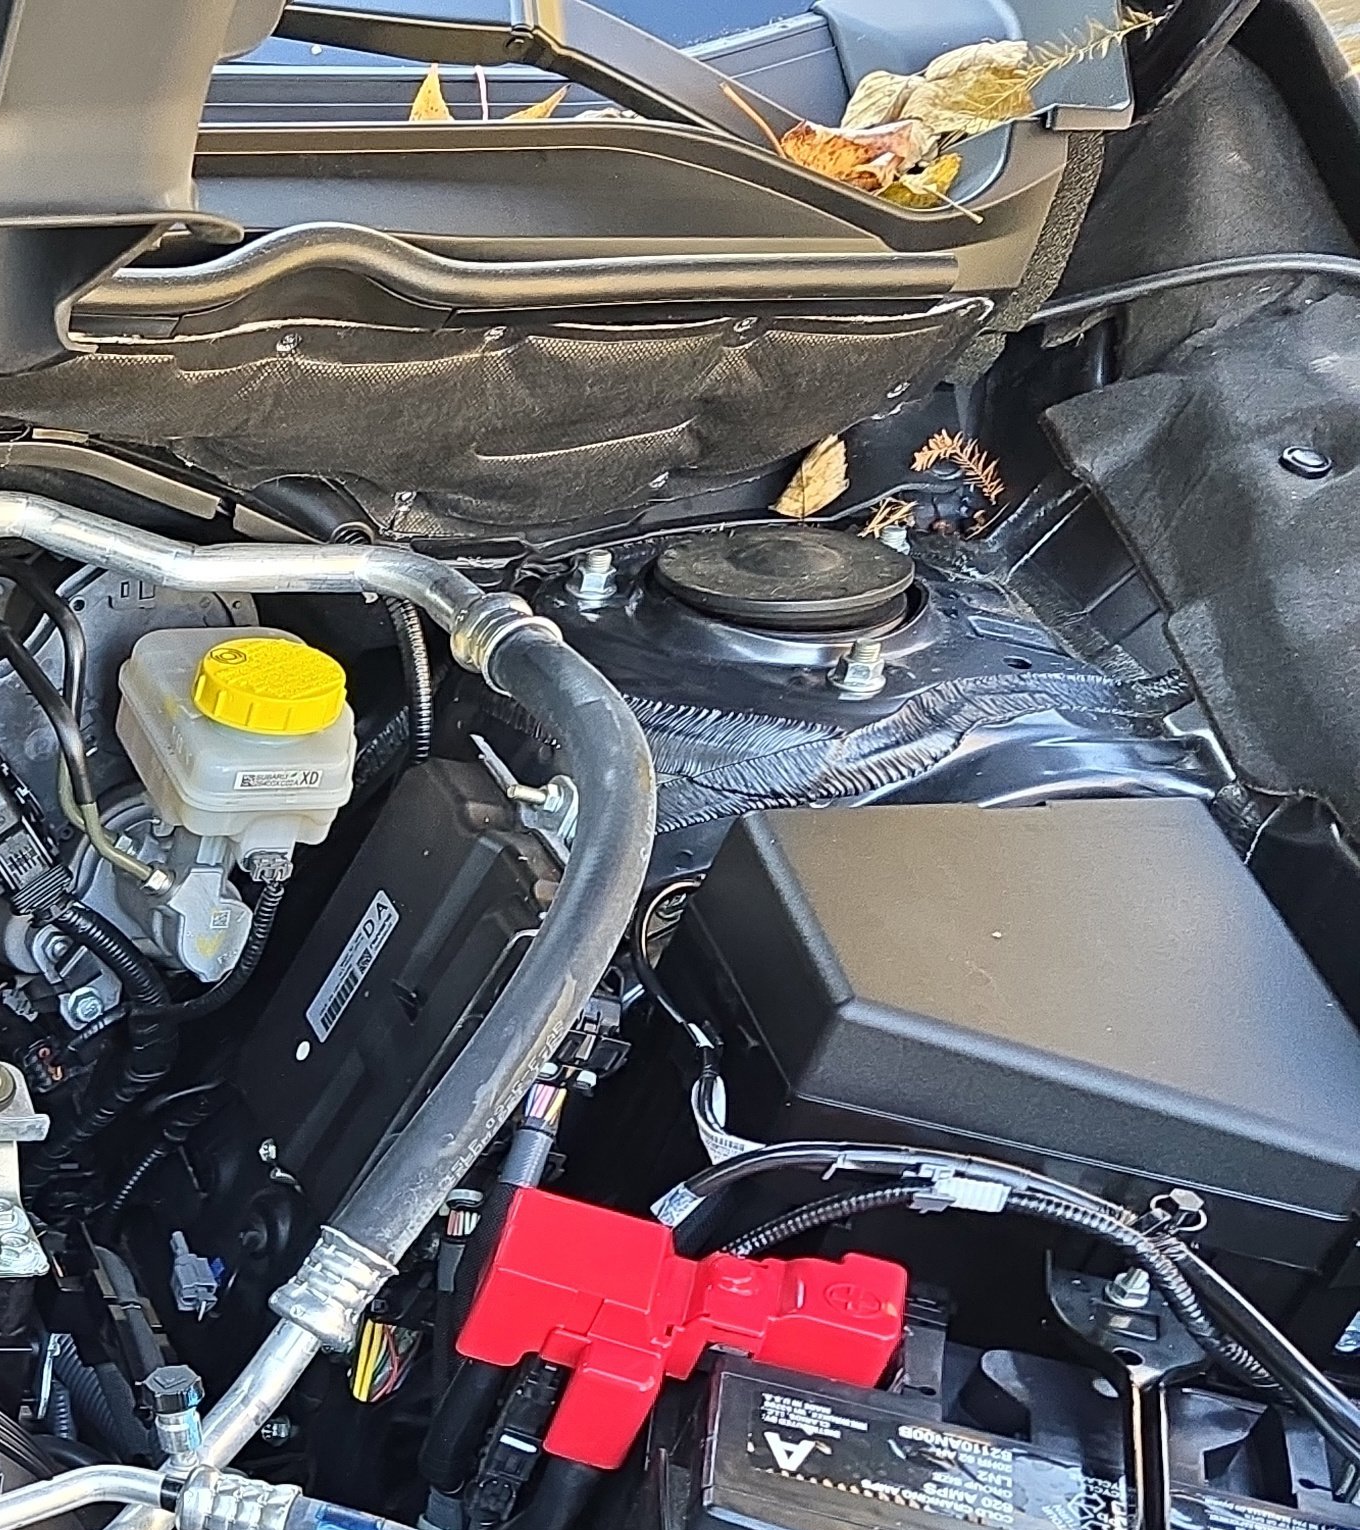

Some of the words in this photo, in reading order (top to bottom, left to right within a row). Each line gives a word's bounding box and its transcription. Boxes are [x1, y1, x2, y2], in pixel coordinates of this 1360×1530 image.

[300, 771, 319, 785] XD
[977, 1470, 1012, 1488] LN2
[923, 1482, 977, 1504] AMPS
[964, 1481, 1013, 1499] GROUP
[901, 1489, 974, 1514] CRANKING
[981, 1497, 1013, 1513] 620
[975, 1508, 1014, 1524] COLD
